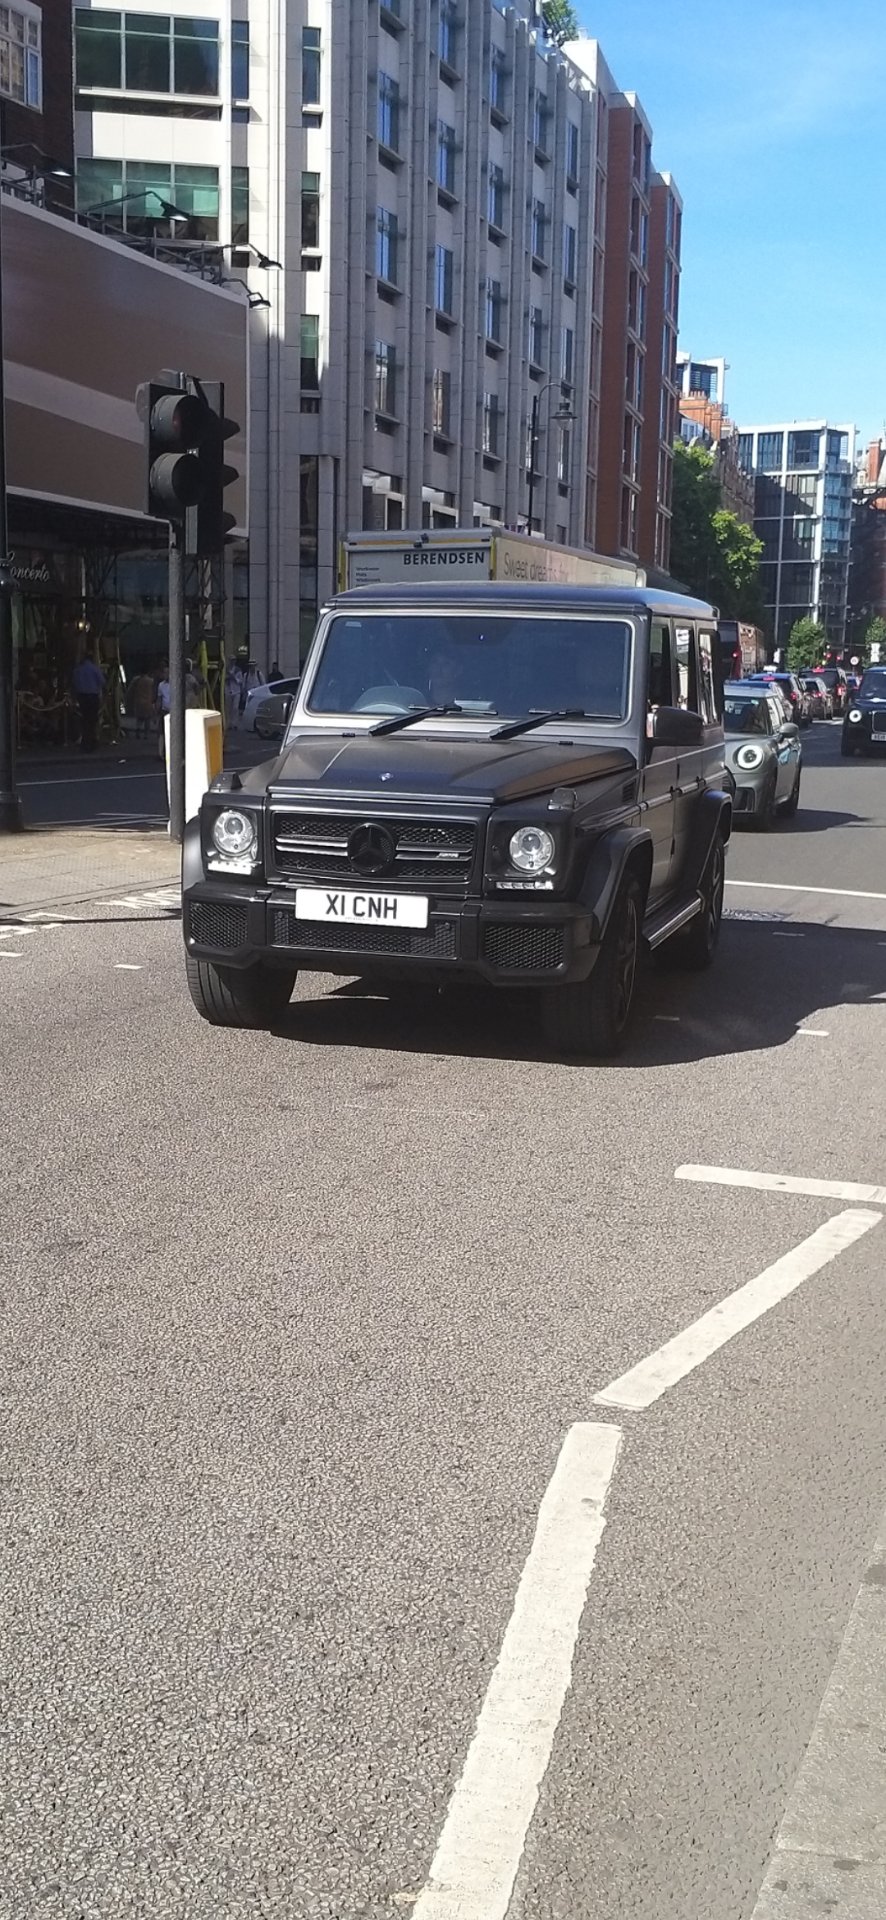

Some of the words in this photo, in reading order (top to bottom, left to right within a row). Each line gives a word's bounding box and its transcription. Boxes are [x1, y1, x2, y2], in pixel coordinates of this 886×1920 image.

[403, 552, 485, 565] BERENDSEN
[504, 552, 528, 579] Sweet
[352, 895, 398, 920] CNH
